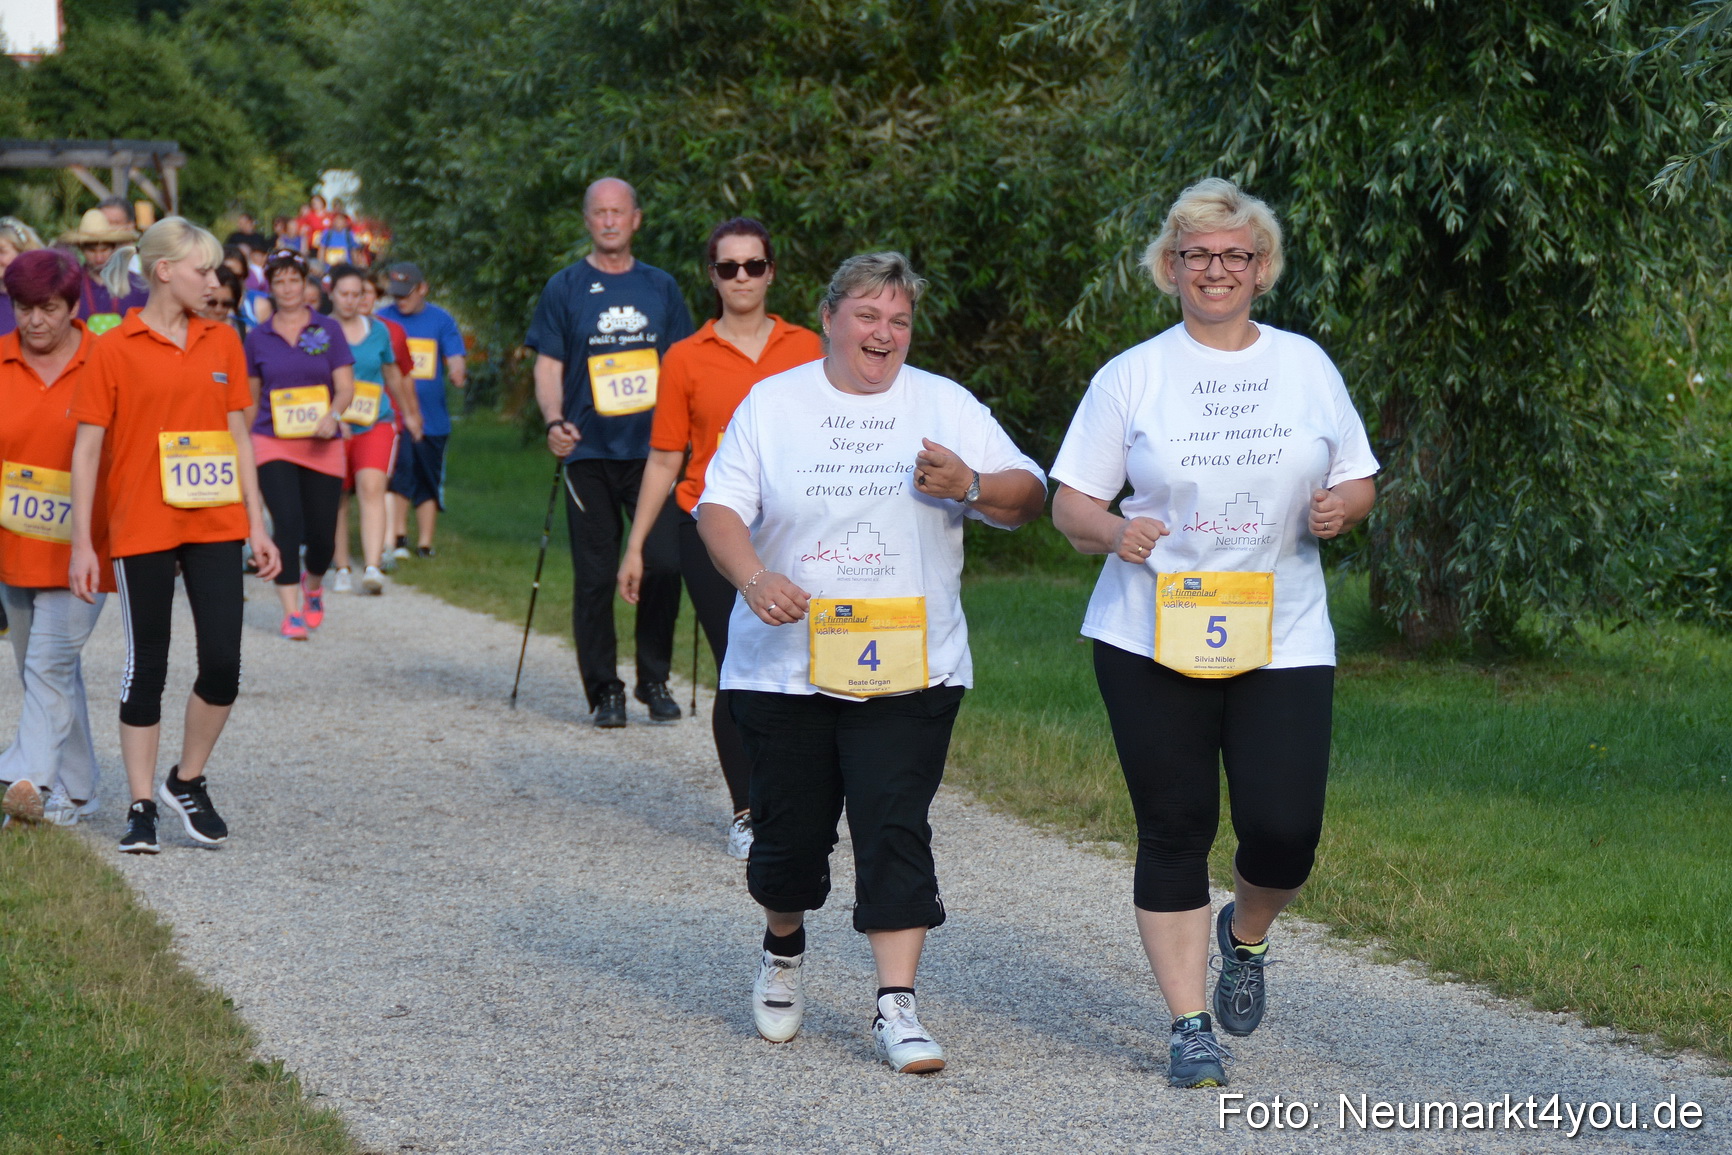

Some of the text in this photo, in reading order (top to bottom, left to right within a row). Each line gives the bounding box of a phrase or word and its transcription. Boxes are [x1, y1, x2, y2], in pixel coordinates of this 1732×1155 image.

[608, 376, 648, 397] 182
[1191, 378, 1269, 395] Alle sind
[284, 406, 318, 425] 706
[1203, 402, 1259, 418] Sieger
[821, 416, 895, 430] Alle sind
[1225, 425, 1292, 440] manche
[830, 437, 884, 454] Sieger
[1181, 449, 1282, 467] etwas eher!
[170, 462, 234, 486] 1035
[849, 461, 913, 474] manche
[806, 481, 902, 497] etwas eher!
[9, 493, 72, 524] 1037
[1183, 512, 1259, 535] aktives
[1216, 534, 1270, 547] Neumarkt
[800, 541, 882, 565] aktives
[837, 565, 895, 576] Neumarkt
[1175, 589, 1218, 597] firmenlauf
[1163, 600, 1197, 608] walken
[828, 615, 869, 624] firmenlauf
[816, 626, 848, 635] walken
[1205, 615, 1228, 649] 5
[857, 640, 881, 671] 4
[869, 678, 891, 686] Grgan
